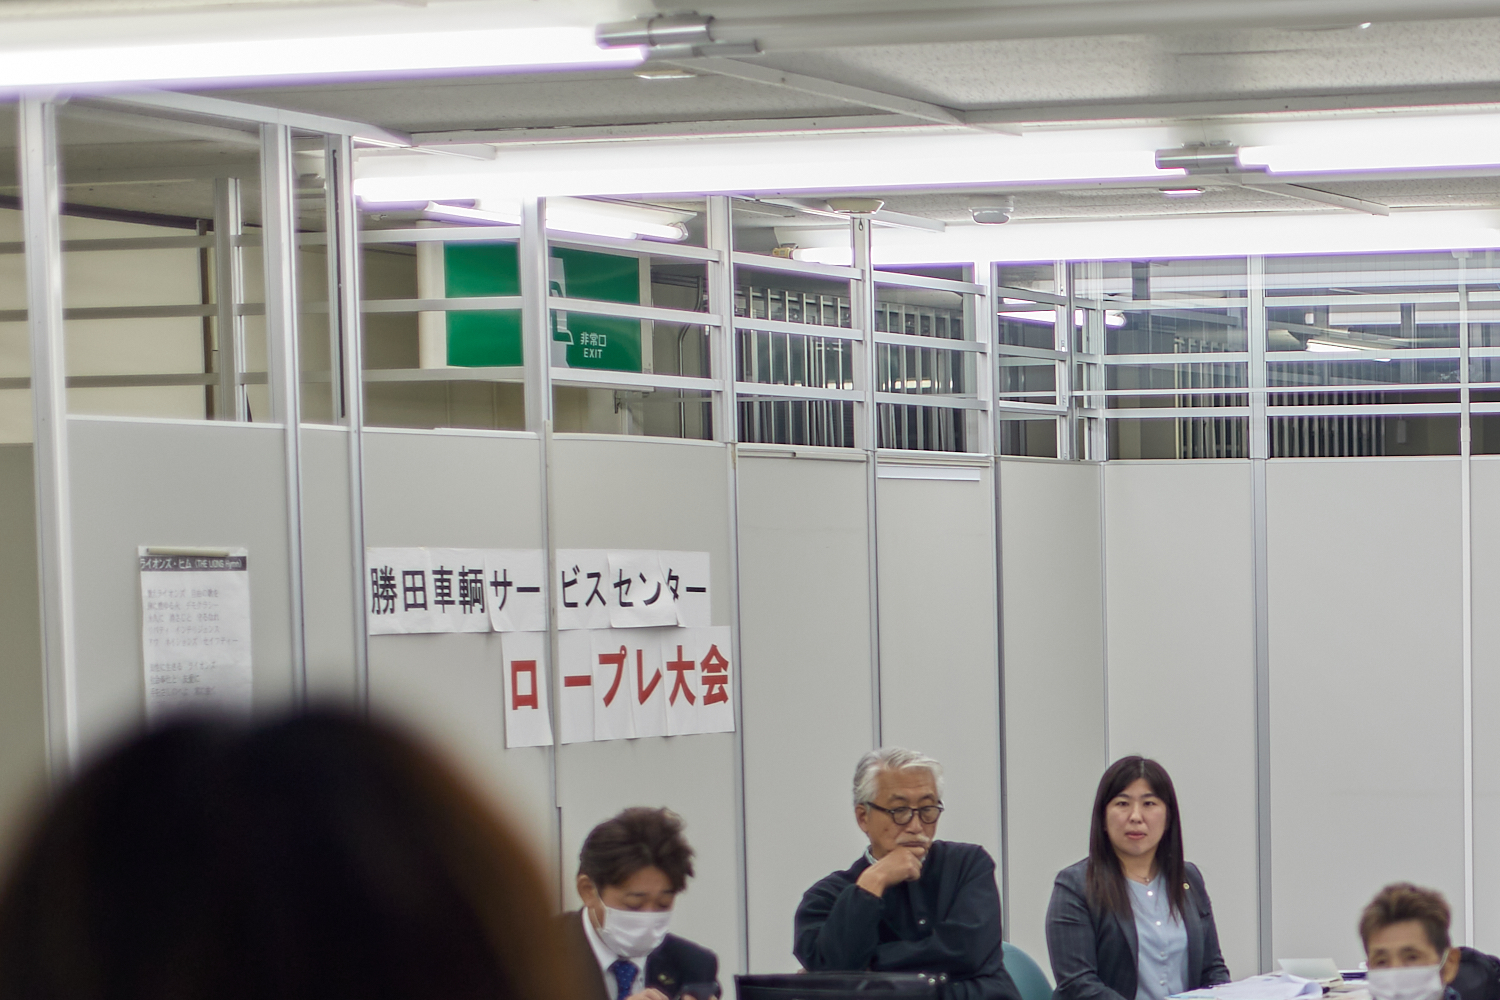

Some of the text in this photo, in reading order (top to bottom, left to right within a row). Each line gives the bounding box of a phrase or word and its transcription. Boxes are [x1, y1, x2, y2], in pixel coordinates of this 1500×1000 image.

[580, 332, 607, 347] 非常口
[583, 348, 603, 358] EXIT
[510, 644, 730, 711] ロープレ大会
